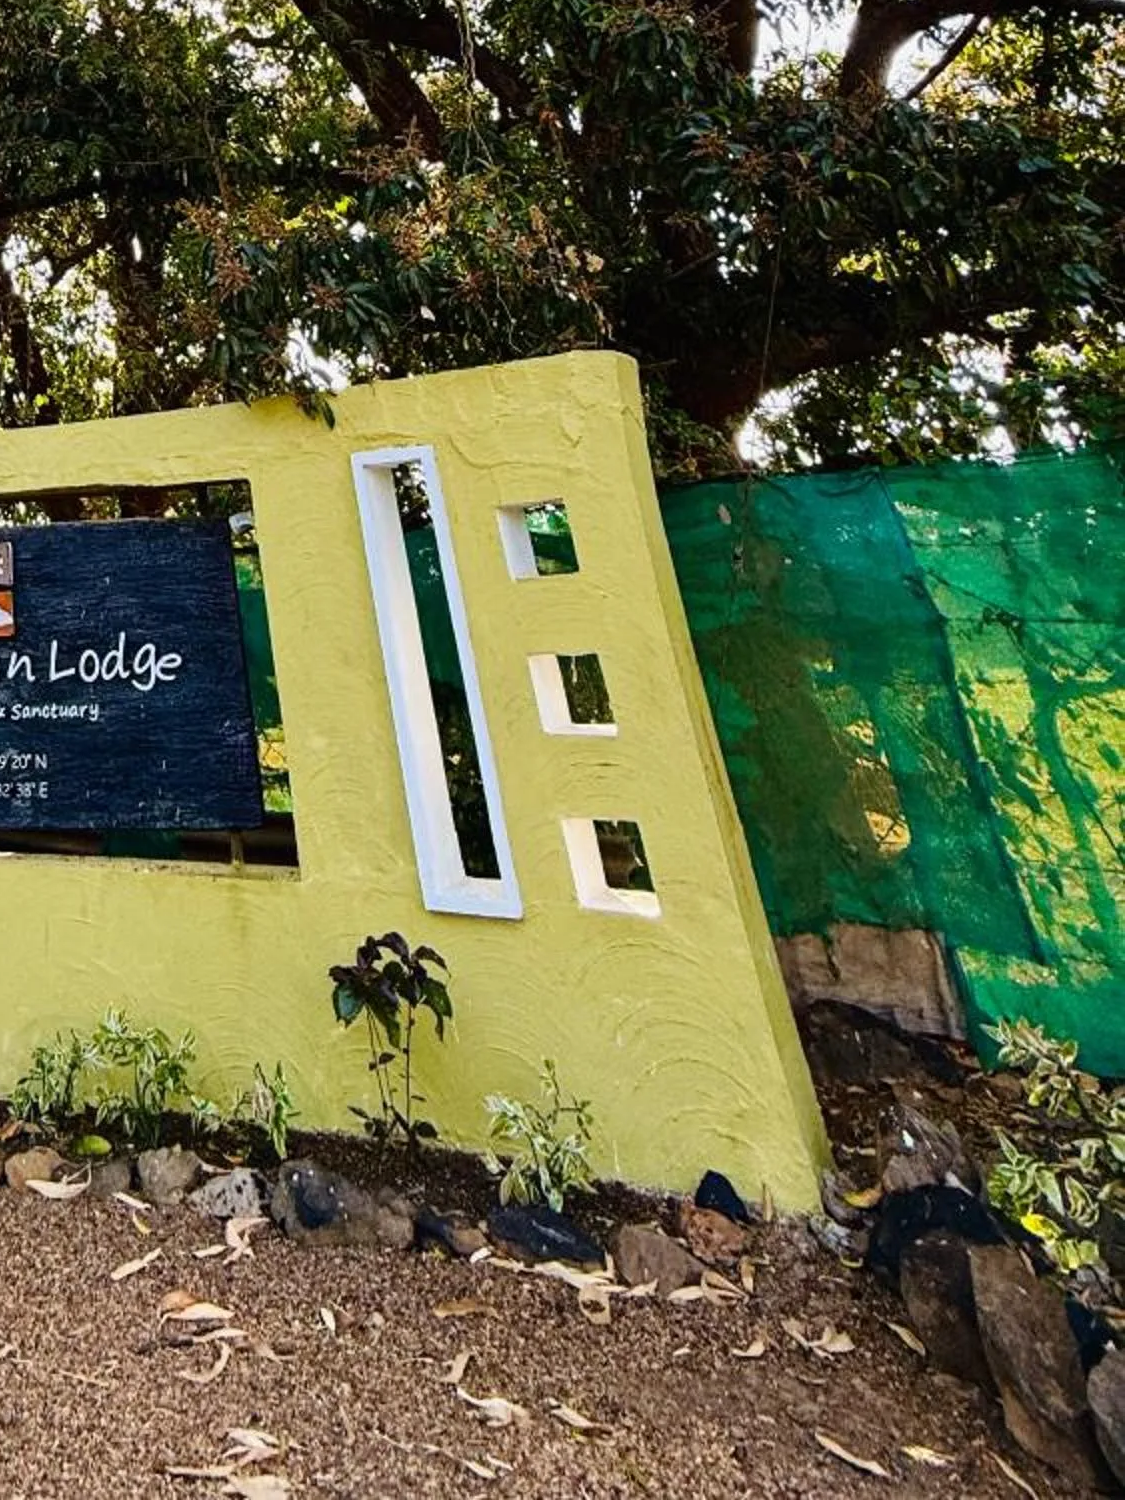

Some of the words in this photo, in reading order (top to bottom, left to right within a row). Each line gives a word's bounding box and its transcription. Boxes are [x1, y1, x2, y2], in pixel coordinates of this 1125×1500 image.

[48, 631, 182, 692] Lodge
[10, 702, 100, 722] Sanctuary
[34, 753, 48, 769] N
[38, 781, 49, 799] E
